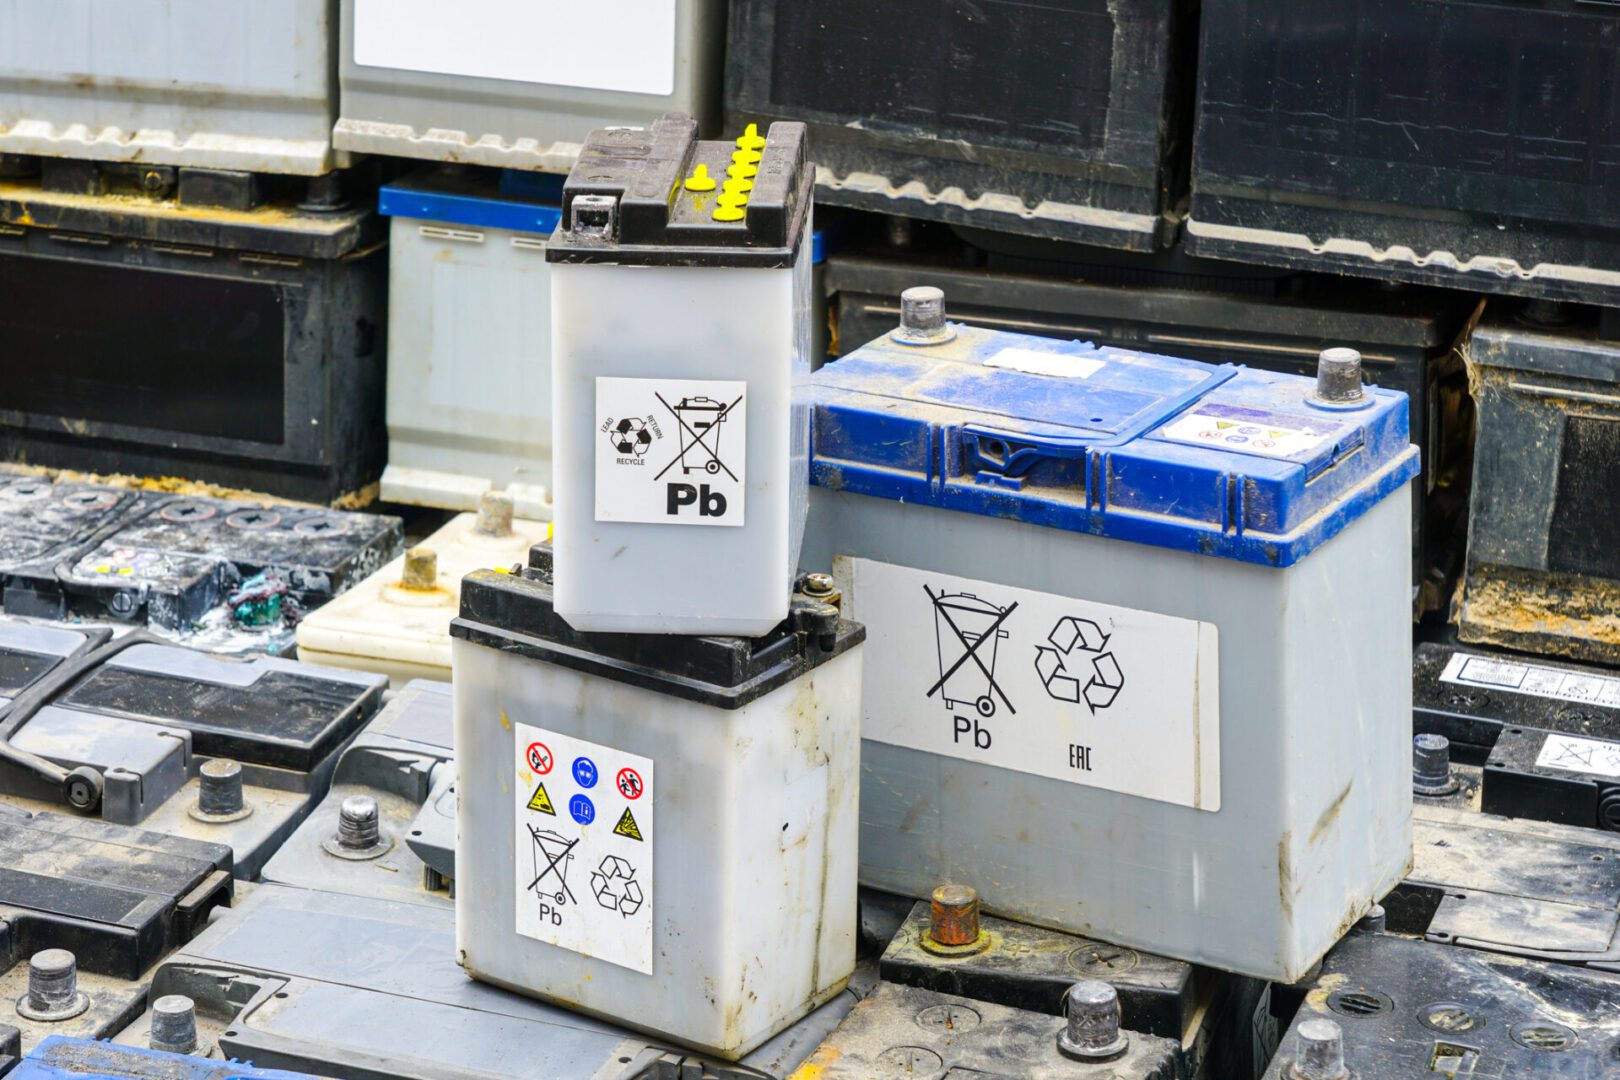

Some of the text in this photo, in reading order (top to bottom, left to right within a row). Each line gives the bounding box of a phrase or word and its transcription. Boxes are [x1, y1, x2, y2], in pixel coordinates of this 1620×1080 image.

[601, 417, 614, 432] LEAD
[647, 415, 664, 439] RETURN
[667, 483, 727, 517] Pb
[954, 715, 992, 749] Pb
[1069, 744, 1092, 771] EAC
[539, 903, 562, 926] Pb
